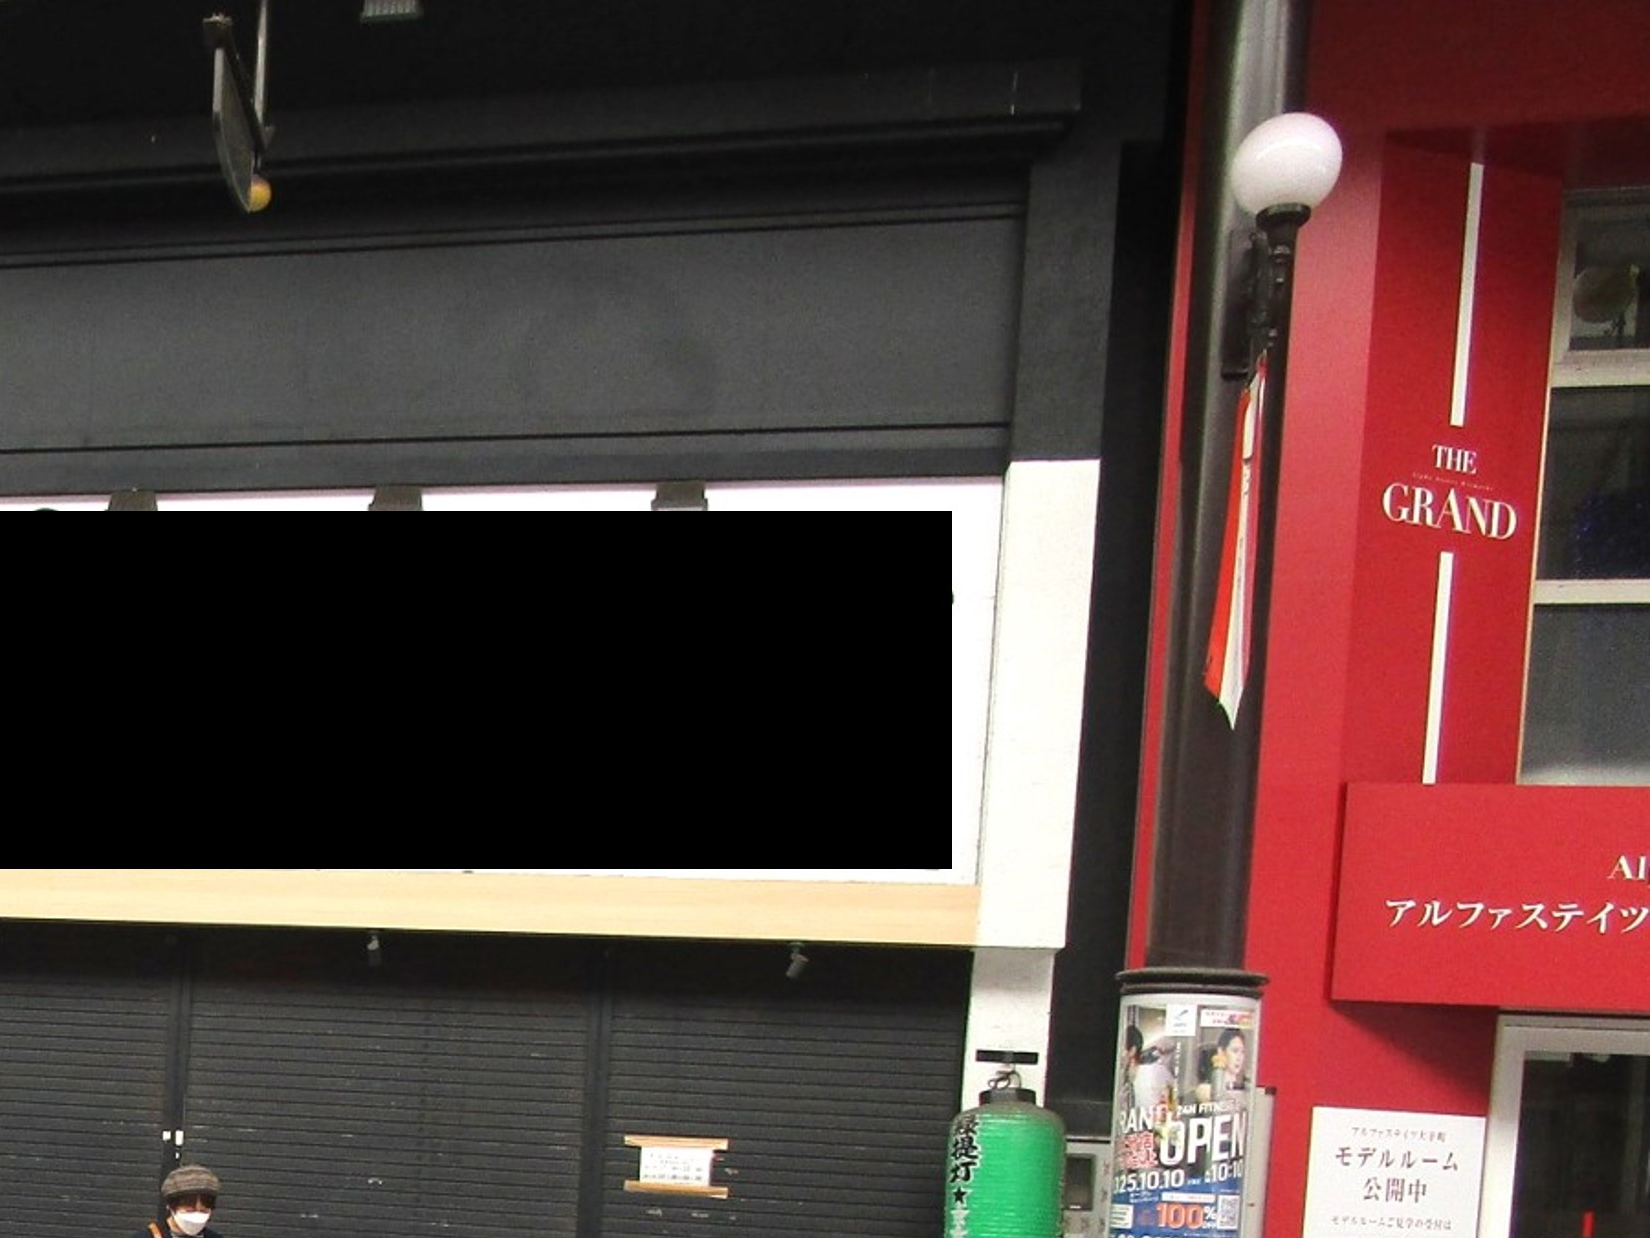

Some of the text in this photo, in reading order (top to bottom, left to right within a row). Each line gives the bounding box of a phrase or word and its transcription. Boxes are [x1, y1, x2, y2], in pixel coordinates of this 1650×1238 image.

[1432, 444, 1477, 474] THE
[1382, 482, 1517, 540] GRAND
[1385, 899, 1650, 933] アルファステイツ
[1160, 1112, 1247, 1166] OPEN
[1335, 1146, 1459, 1172] モデルルーム
[1363, 1176, 1427, 1203] 公開中
